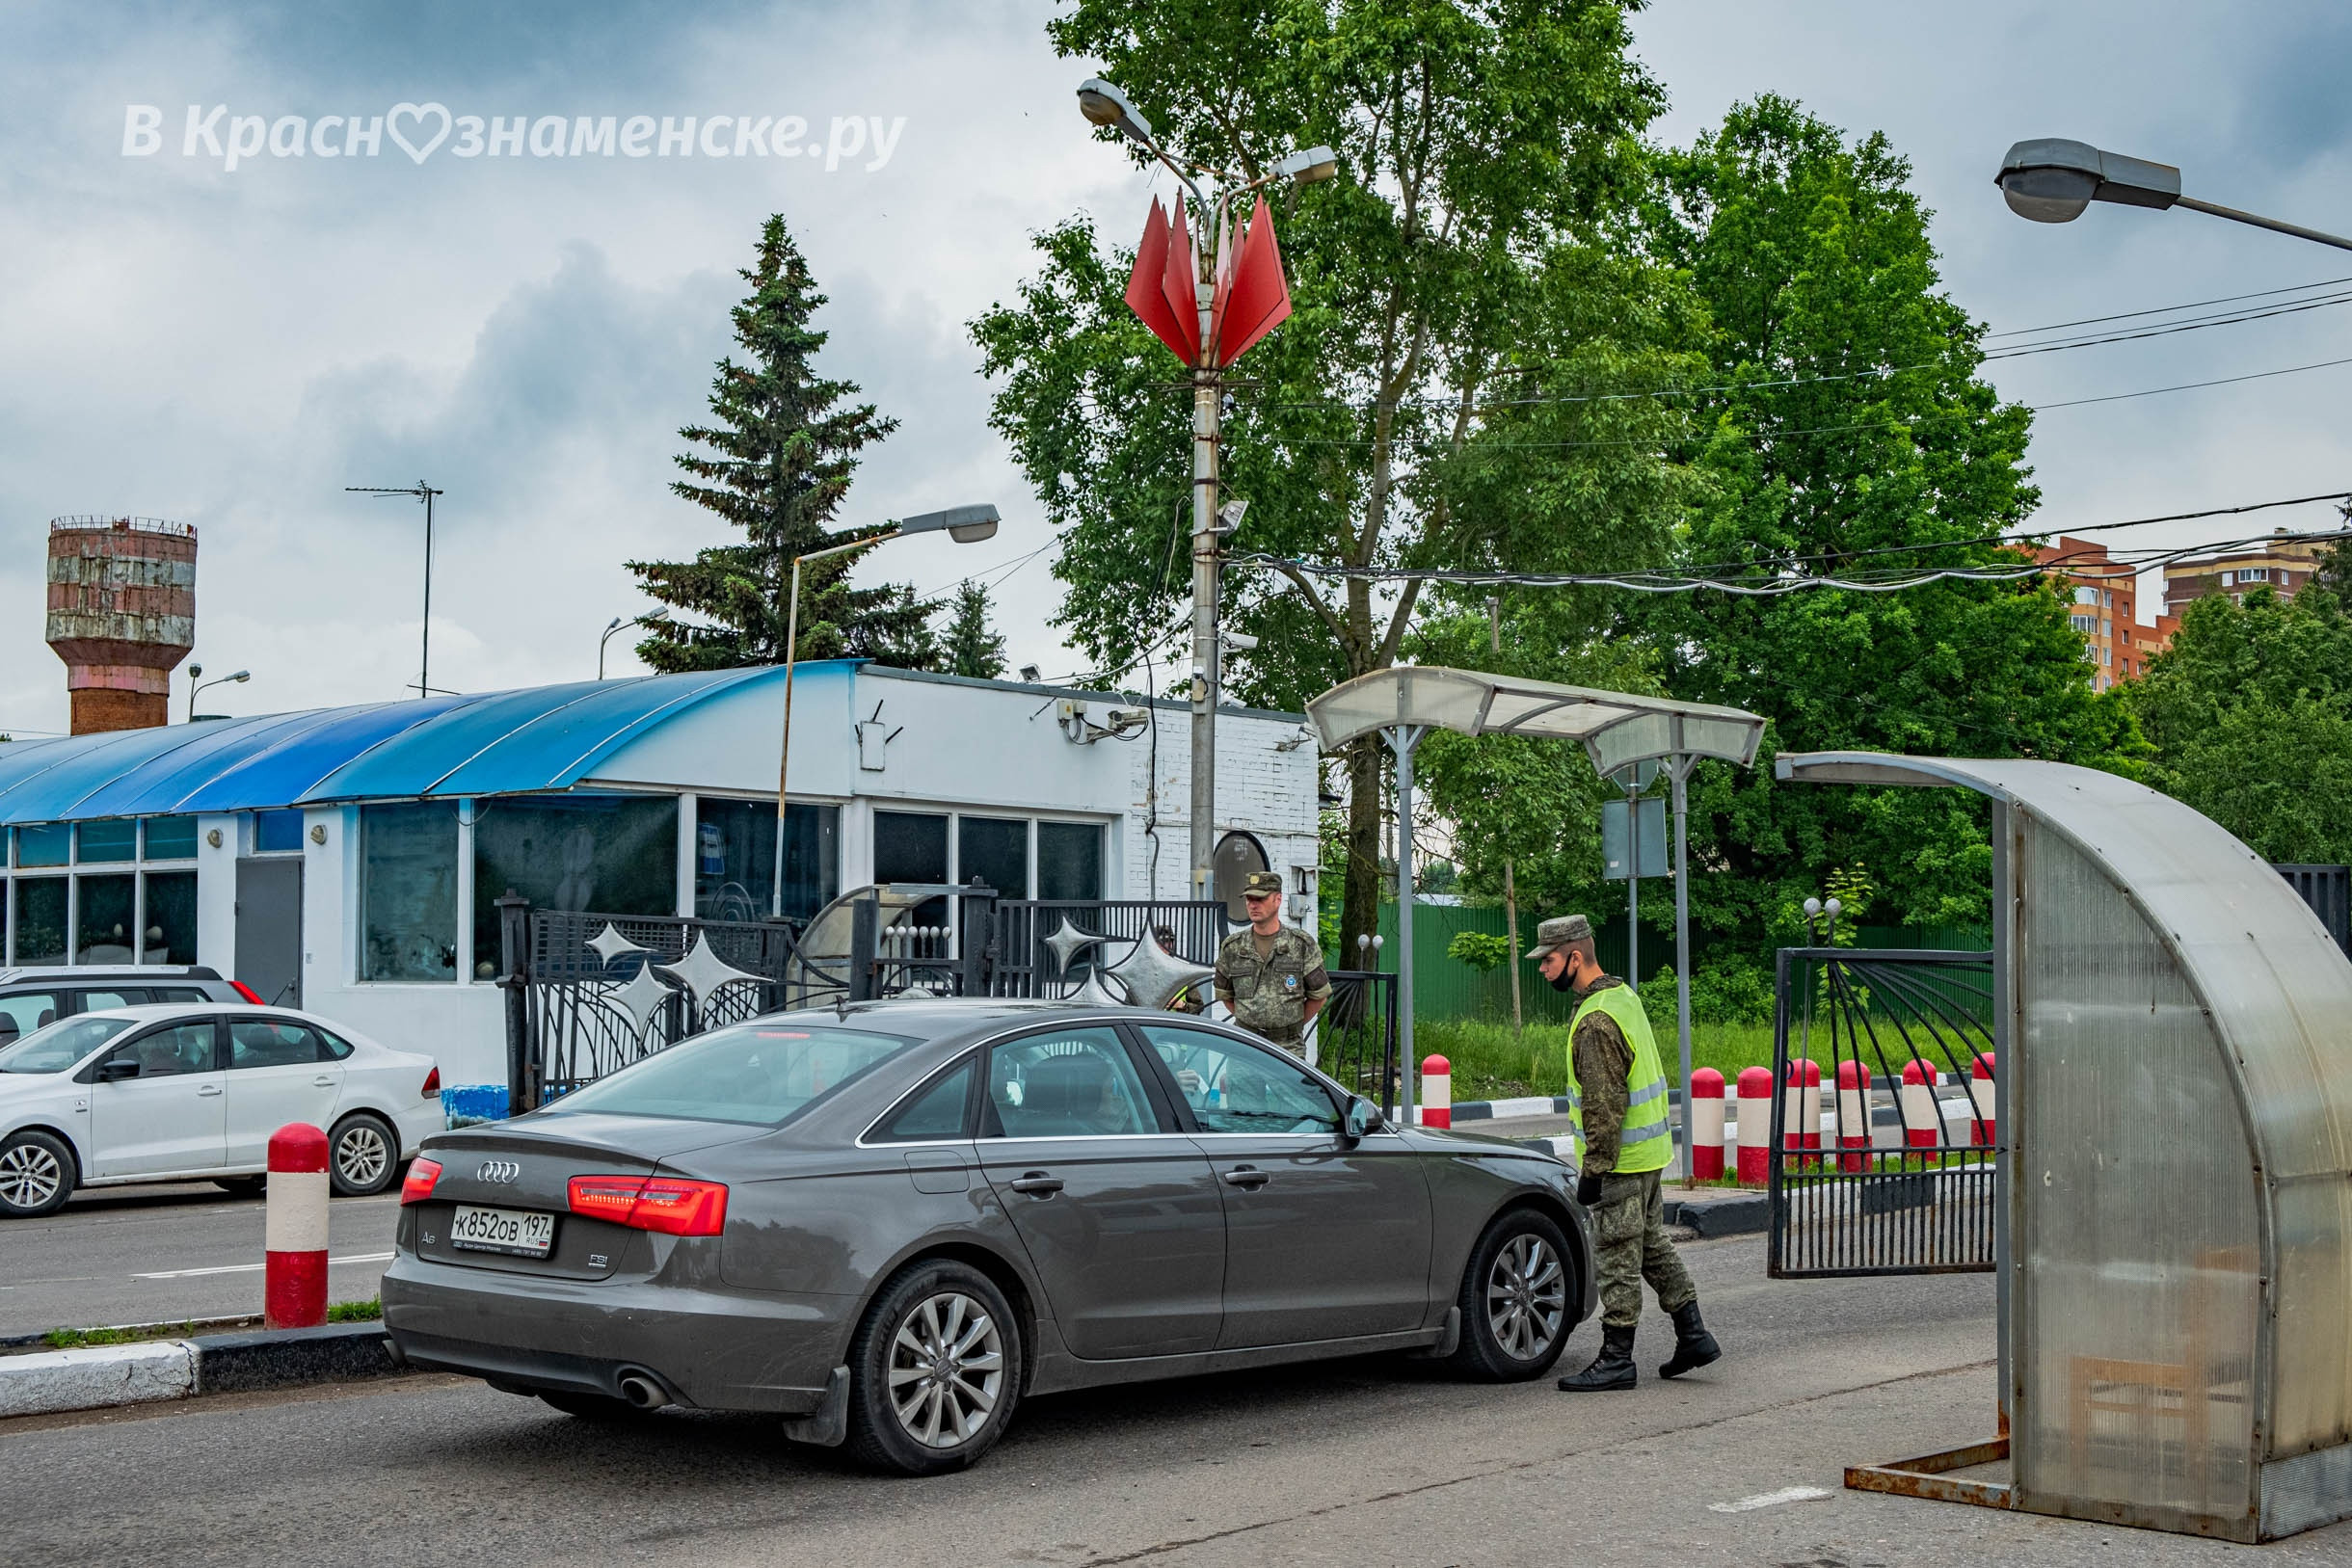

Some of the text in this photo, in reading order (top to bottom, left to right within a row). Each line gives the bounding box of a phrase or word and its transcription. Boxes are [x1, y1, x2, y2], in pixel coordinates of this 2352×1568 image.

[523, 1214, 549, 1237] 197
[421, 1231, 437, 1244] A6
[525, 1236, 539, 1246] RUS
[590, 1254, 608, 1263] FSI
